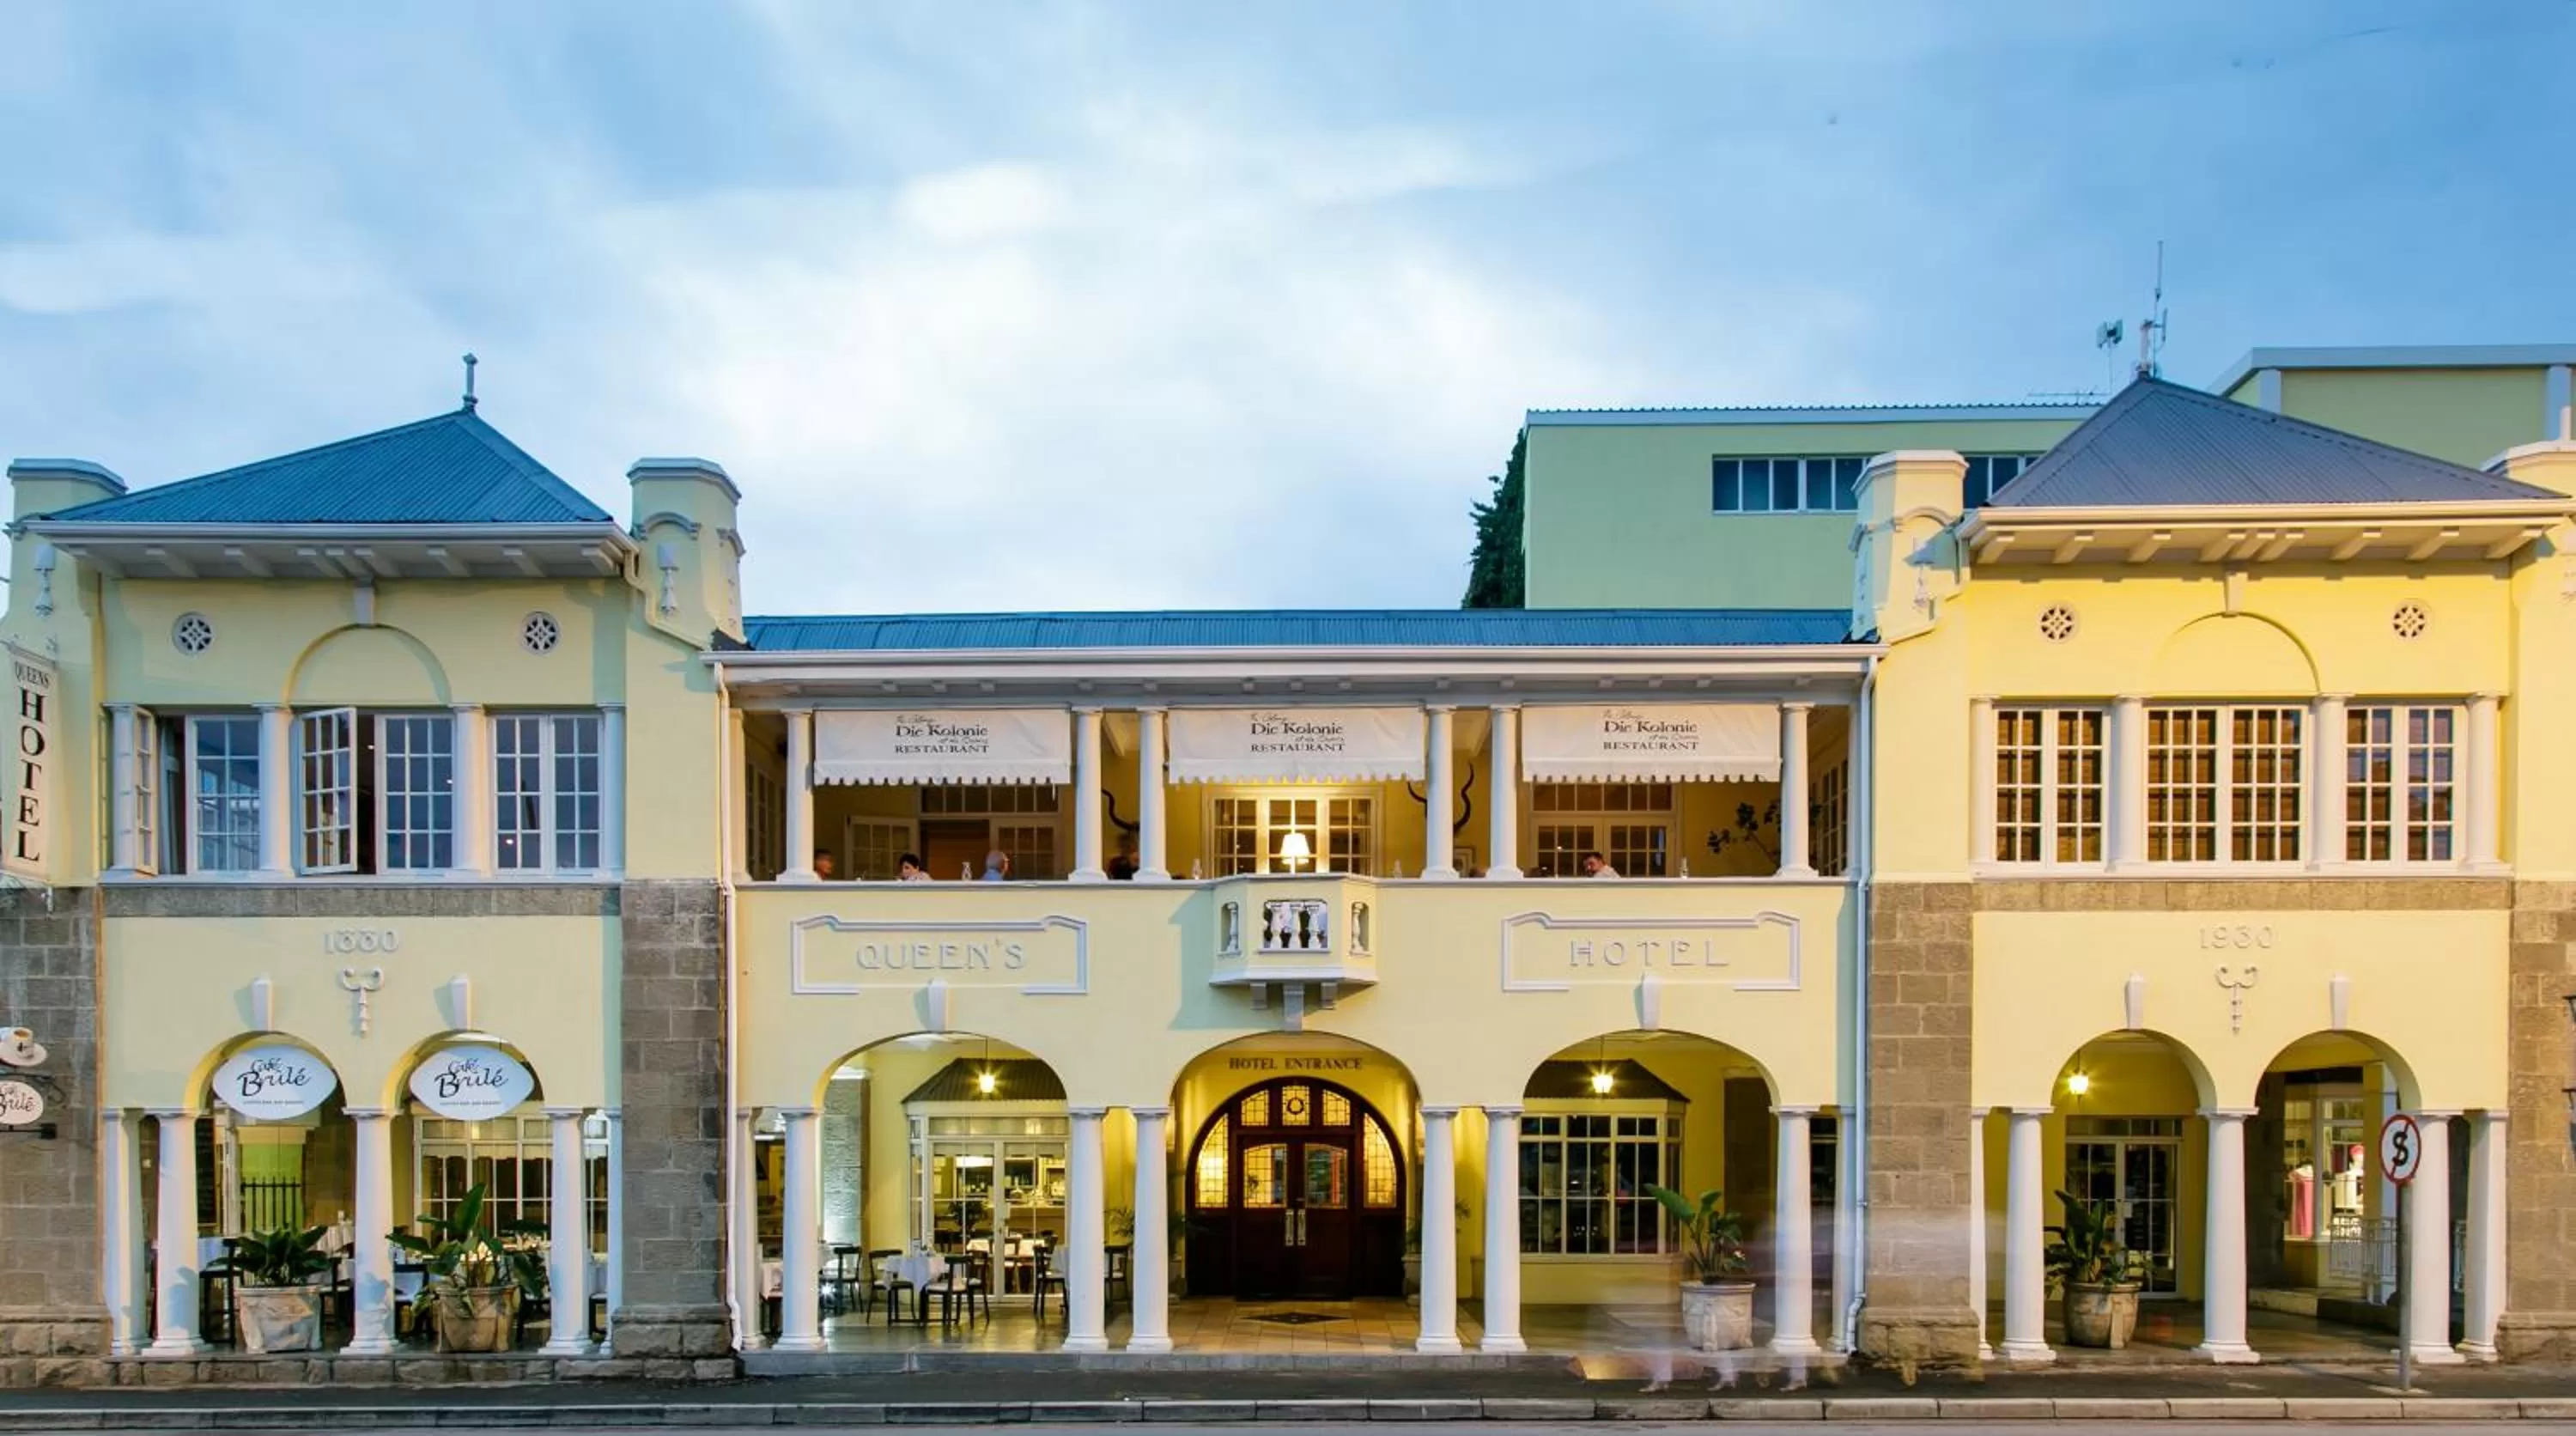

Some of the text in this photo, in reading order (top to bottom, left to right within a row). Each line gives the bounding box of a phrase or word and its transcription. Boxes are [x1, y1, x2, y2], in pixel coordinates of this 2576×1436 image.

[895, 724, 988, 737] Die Kolonie
[1250, 721, 1343, 734] Die Kolonie
[1604, 720, 1698, 733] Die Kolonie
[895, 745, 989, 753] RESTAURANT
[1250, 743, 1345, 751] RESTAURANT
[1603, 741, 1698, 750] RESTAURANT
[15, 686, 46, 862] HOTEL
[2198, 925, 2275, 950] 1930
[856, 937, 1026, 971] QUEEN'S
[1569, 940, 1729, 967] HOTEL
[251, 1057, 283, 1073] Café
[447, 1057, 479, 1074] Café
[1229, 1057, 1364, 1070] HOTEL ENTRANCE
[236, 1066, 312, 1097] Brulé
[434, 1068, 509, 1098] Brulé
